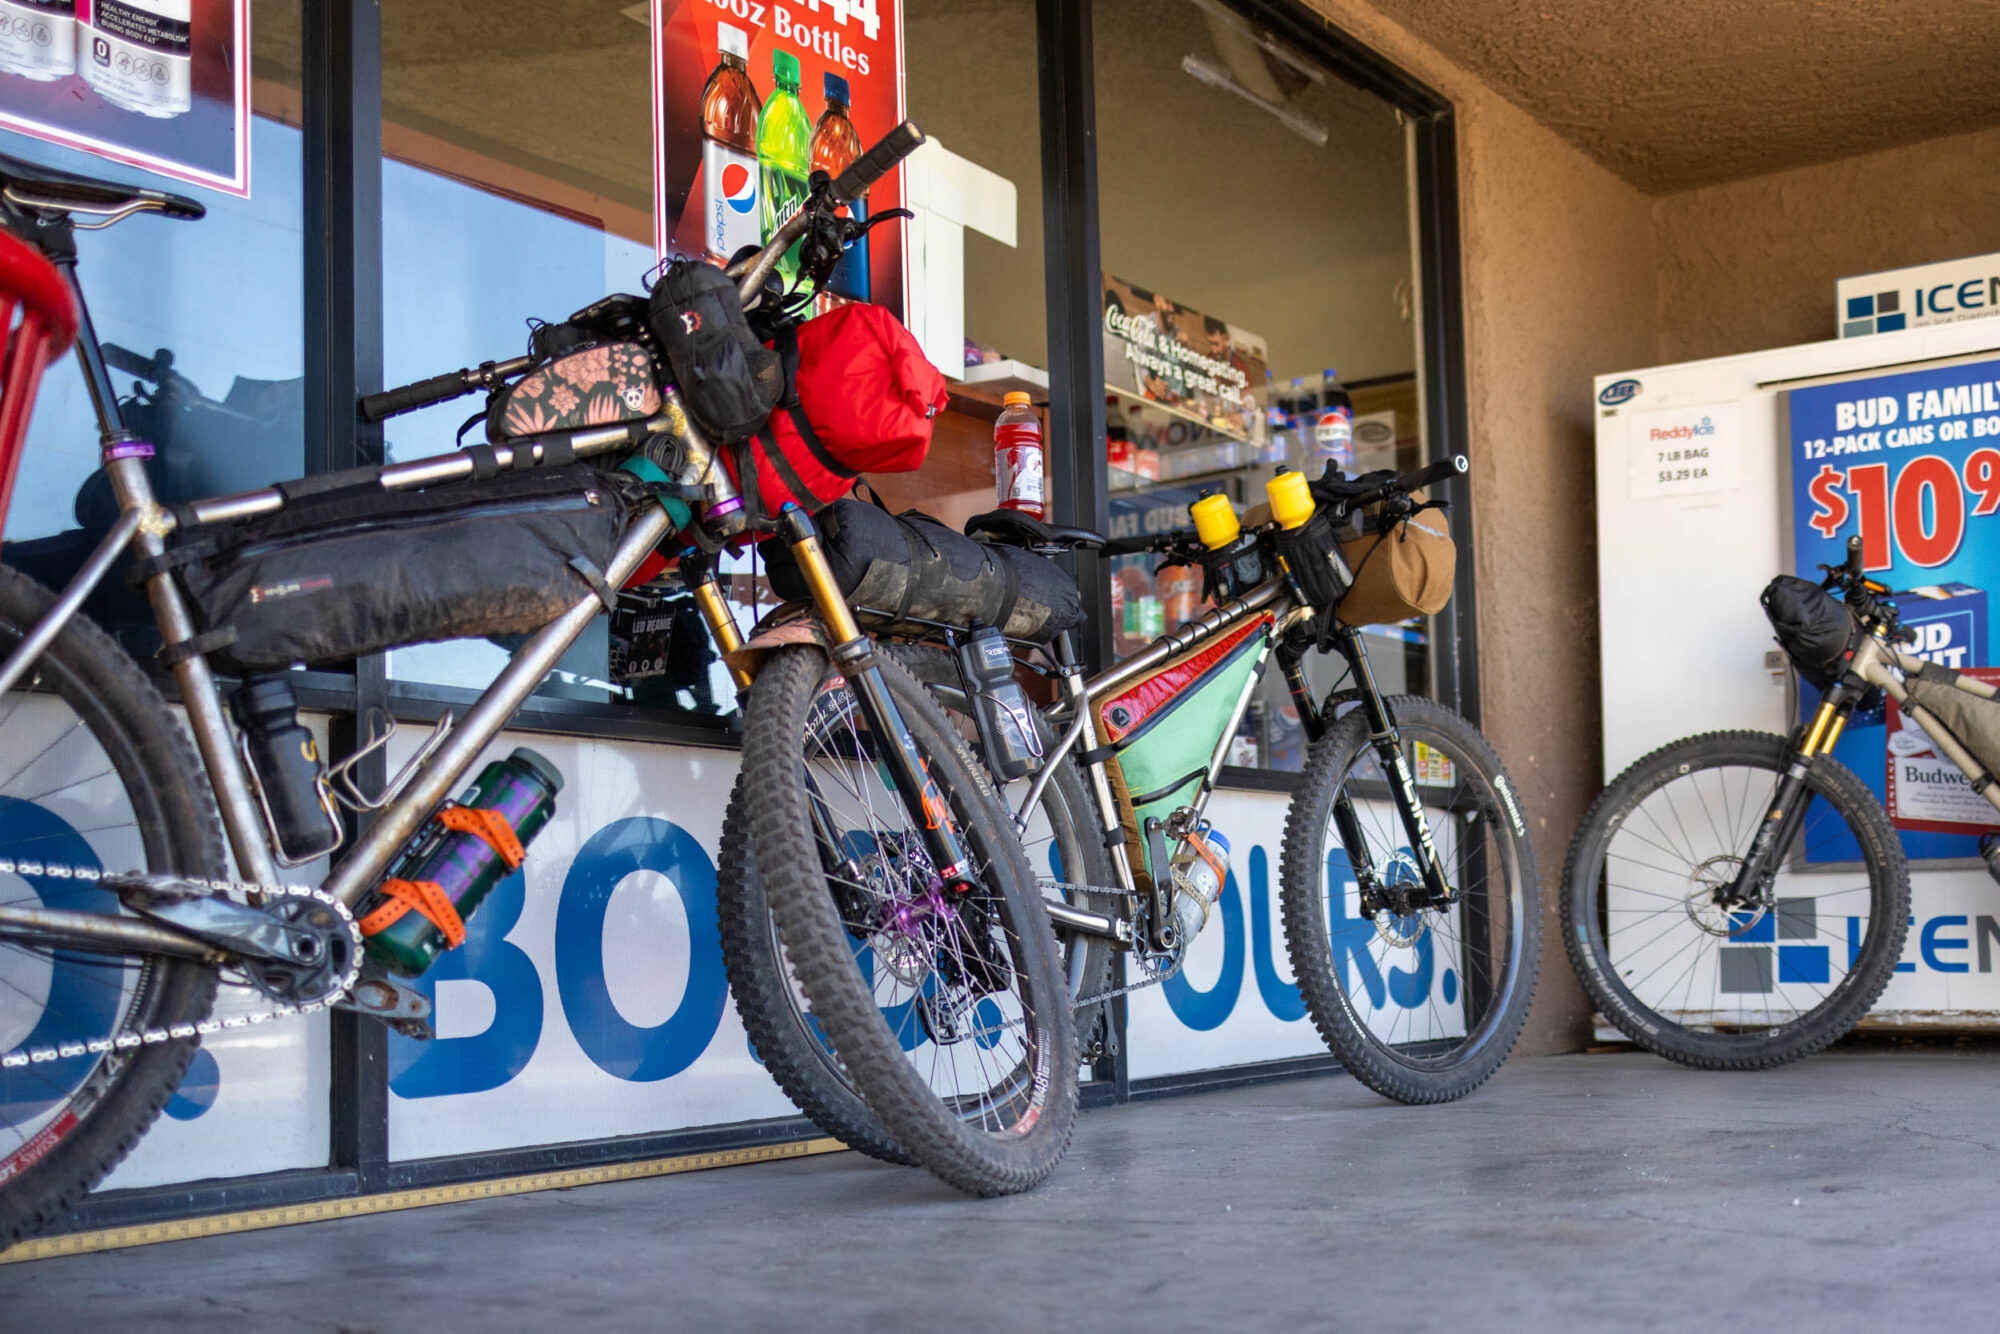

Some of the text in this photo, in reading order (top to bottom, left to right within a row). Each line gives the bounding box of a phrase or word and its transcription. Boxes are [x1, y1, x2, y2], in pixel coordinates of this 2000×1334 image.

[101, 2, 158, 27] HEALTHY ENERGY
[101, 10, 189, 43] ACCELERATES METABOLISM
[101, 19, 124, 34] BURNS
[125, 28, 142, 41] BODY
[774, 4, 870, 76] Bottles
[715, 198, 727, 252] pepsi
[1159, 335, 1169, 354] &
[1125, 342, 1173, 377] Always
[1173, 365, 1183, 380] a
[1184, 370, 1218, 395] great
[1836, 396, 1899, 432] BUD
[1658, 448, 1709, 463] 7 LB BAG
[1804, 431, 1882, 460] 12-PACK
[1885, 424, 1935, 449] CANS
[1939, 420, 1968, 442] OR
[1658, 467, 1709, 483] $3.29 EA
[632, 620, 646, 634] LED
[1907, 621, 1952, 655] UD
[955, 744, 991, 797] SPECIALIZED
[1904, 766, 1970, 786] Budwe
[1494, 774, 1523, 828] Continental
